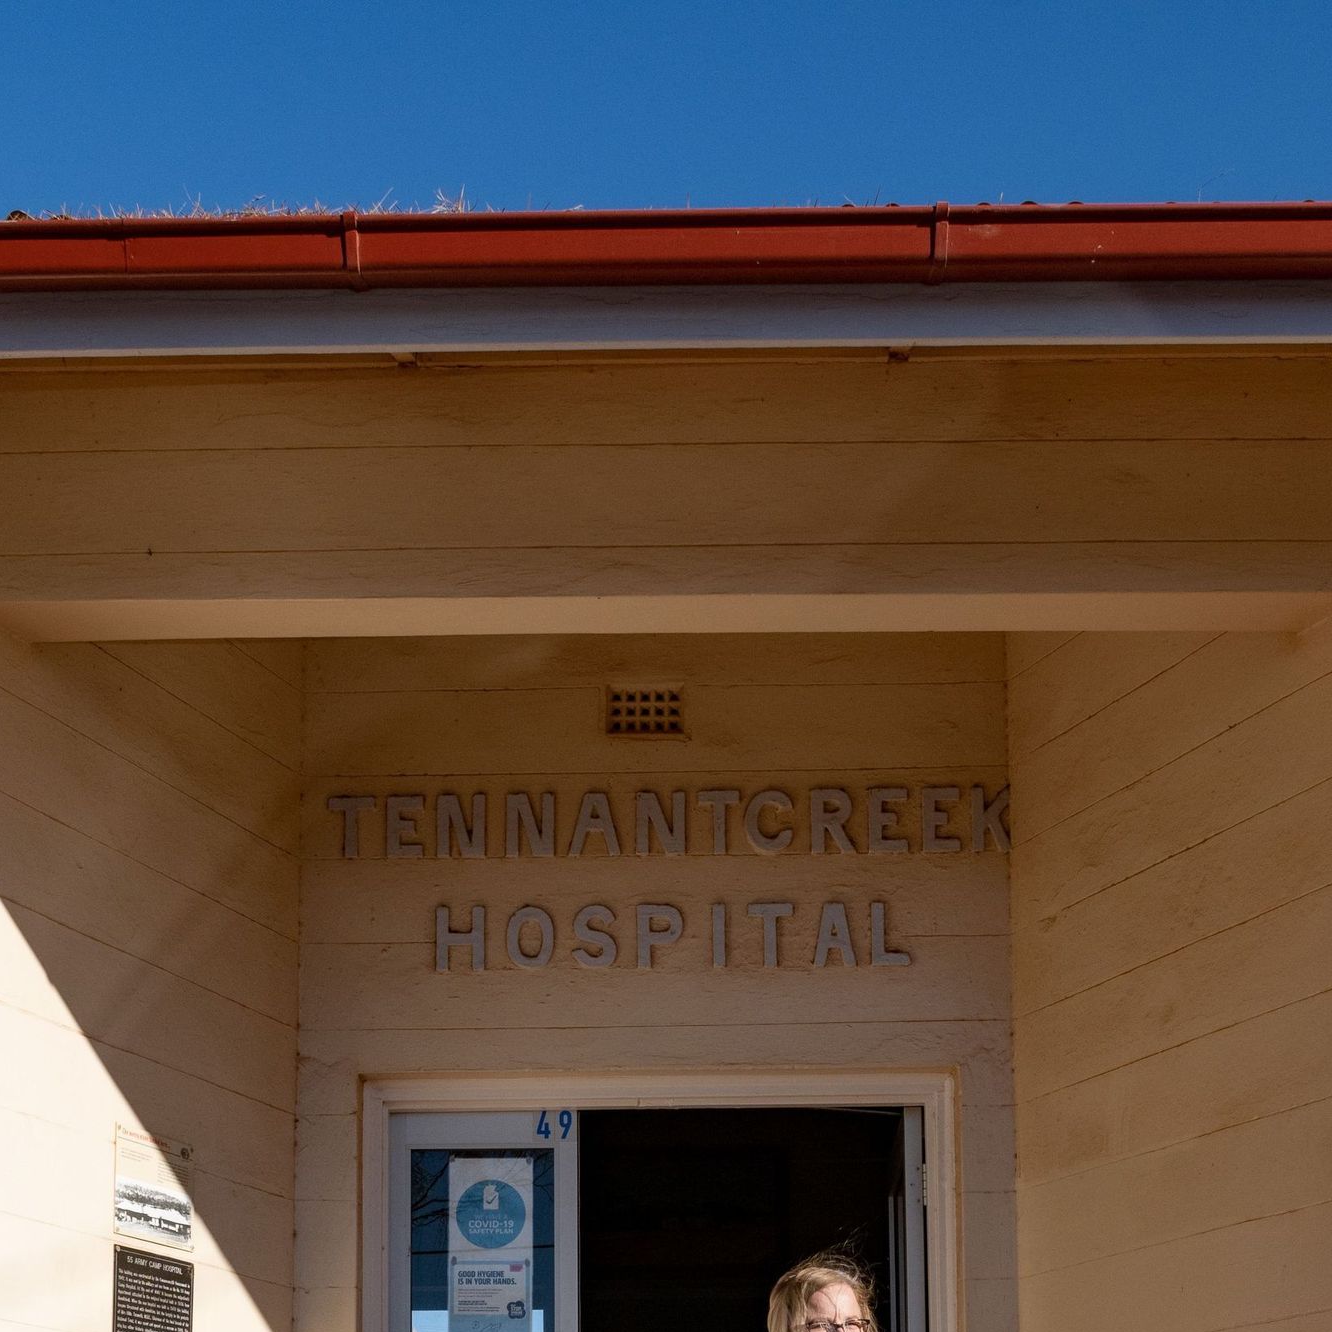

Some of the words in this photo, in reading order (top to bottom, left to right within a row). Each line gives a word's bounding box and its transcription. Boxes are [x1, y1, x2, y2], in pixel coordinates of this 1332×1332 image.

[434, 901, 912, 972] HOSPITAL
[536, 1110, 573, 1140] 49
[468, 1220, 515, 1228] COVID-19
[134, 1257, 148, 1267] ARMY
[148, 1260, 162, 1270] CAMP
[162, 1263, 183, 1275] HOSPITAL
[458, 1270, 476, 1278] GOOD
[477, 1270, 505, 1278] HYGIENE
